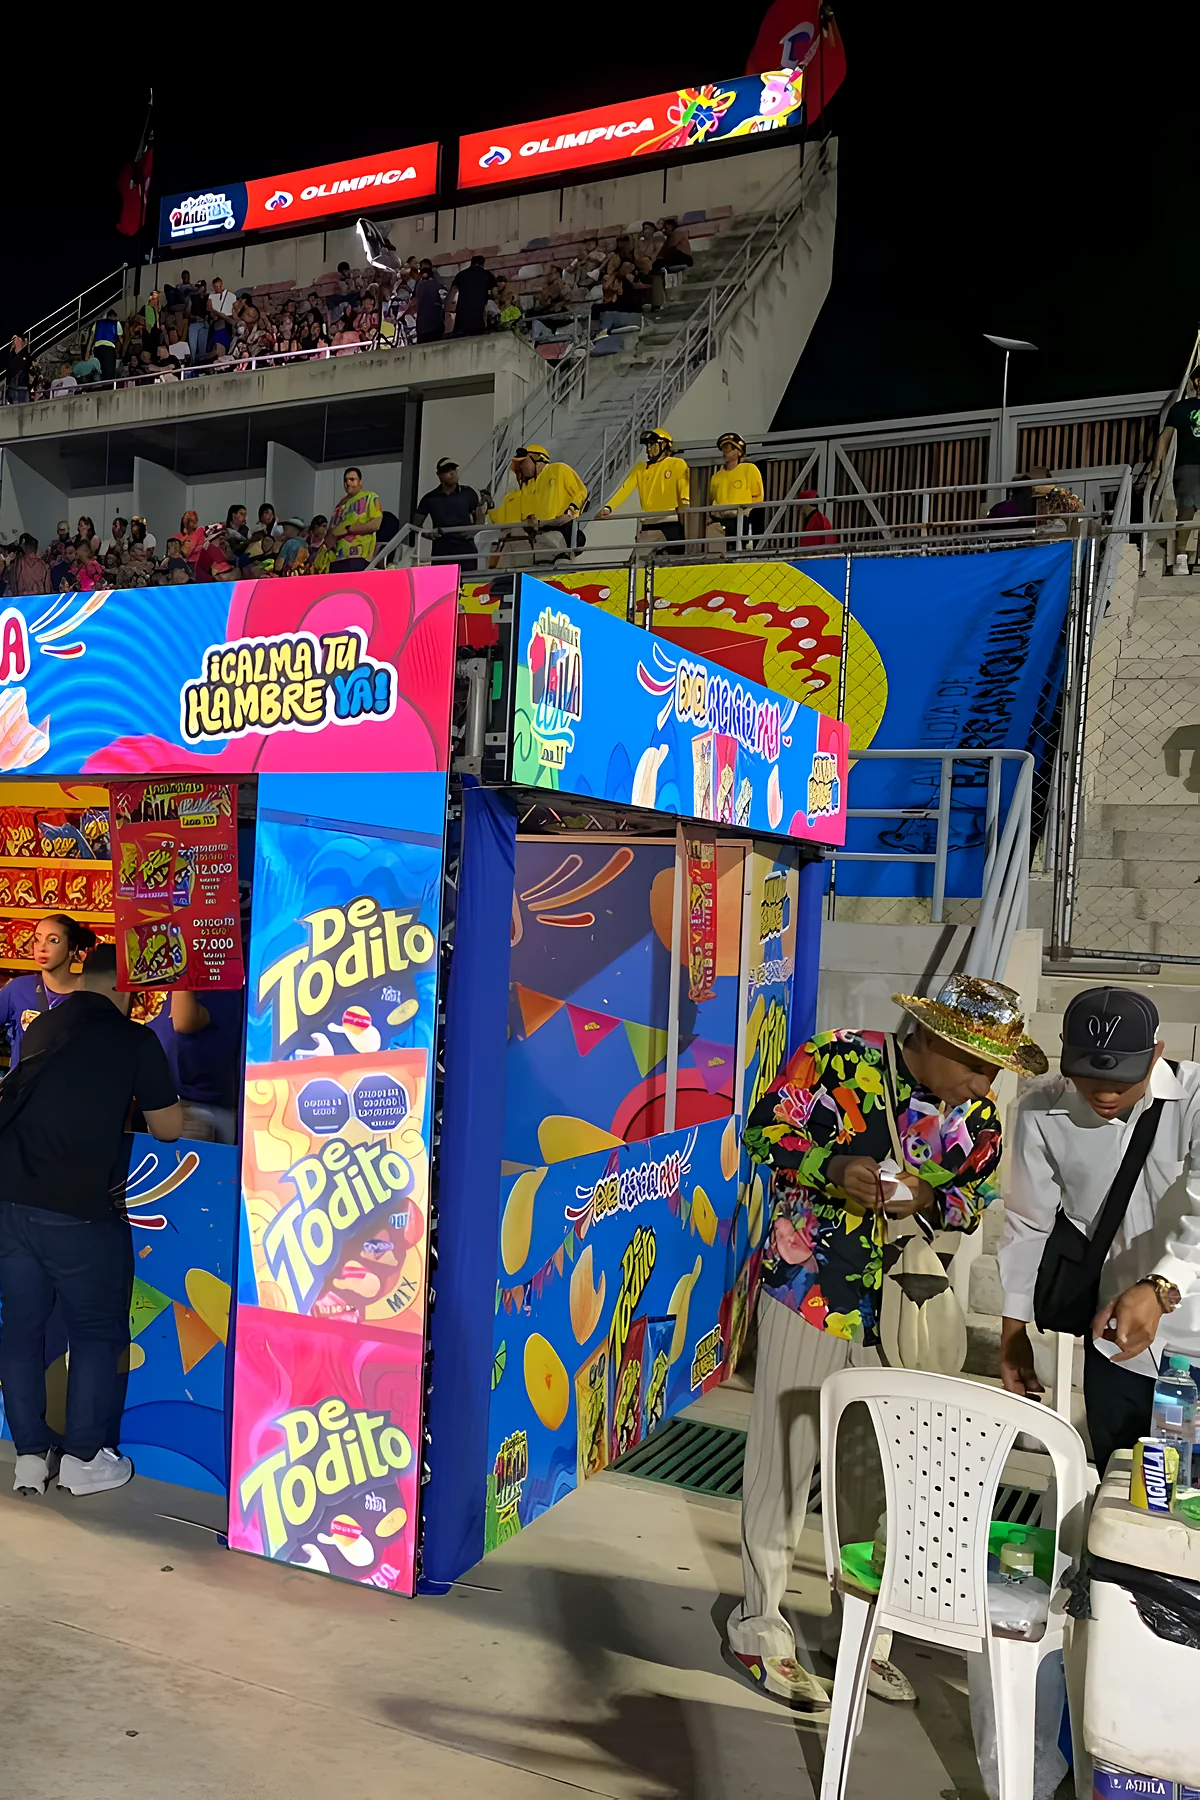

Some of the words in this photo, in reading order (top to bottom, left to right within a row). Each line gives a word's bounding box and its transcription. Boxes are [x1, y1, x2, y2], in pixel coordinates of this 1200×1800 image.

[519, 117, 656, 157] OLIMPICA
[300, 166, 418, 200] OLIMPICA
[210, 641, 310, 688] ¡CALMA
[321, 636, 357, 674] TU
[187, 680, 325, 740] HAMBRE
[333, 666, 388, 718] YA!
[303, 898, 378, 958] De
[258, 910, 435, 1046] Todito
[289, 1141, 350, 1210] De
[265, 1145, 410, 1301] Todito
[386, 1276, 418, 1313] MIX
[276, 1400, 350, 1462] De
[240, 1412, 412, 1558] Todito
[1143, 1451, 1169, 1509] AGUILA
